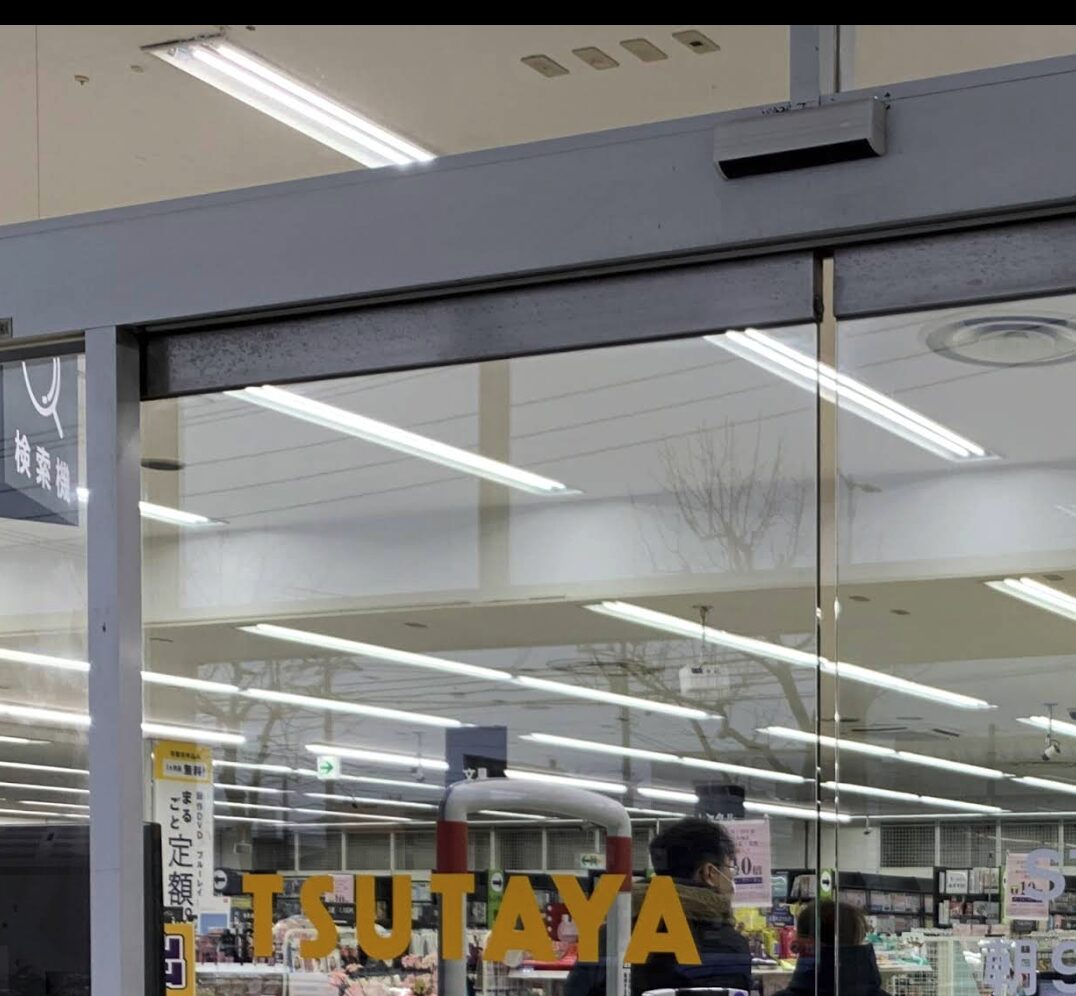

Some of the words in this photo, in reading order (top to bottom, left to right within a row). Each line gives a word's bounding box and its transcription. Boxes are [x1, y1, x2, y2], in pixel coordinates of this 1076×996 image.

[14, 428, 71, 503] 検索機
[242, 873, 702, 966] TSUTAYA
